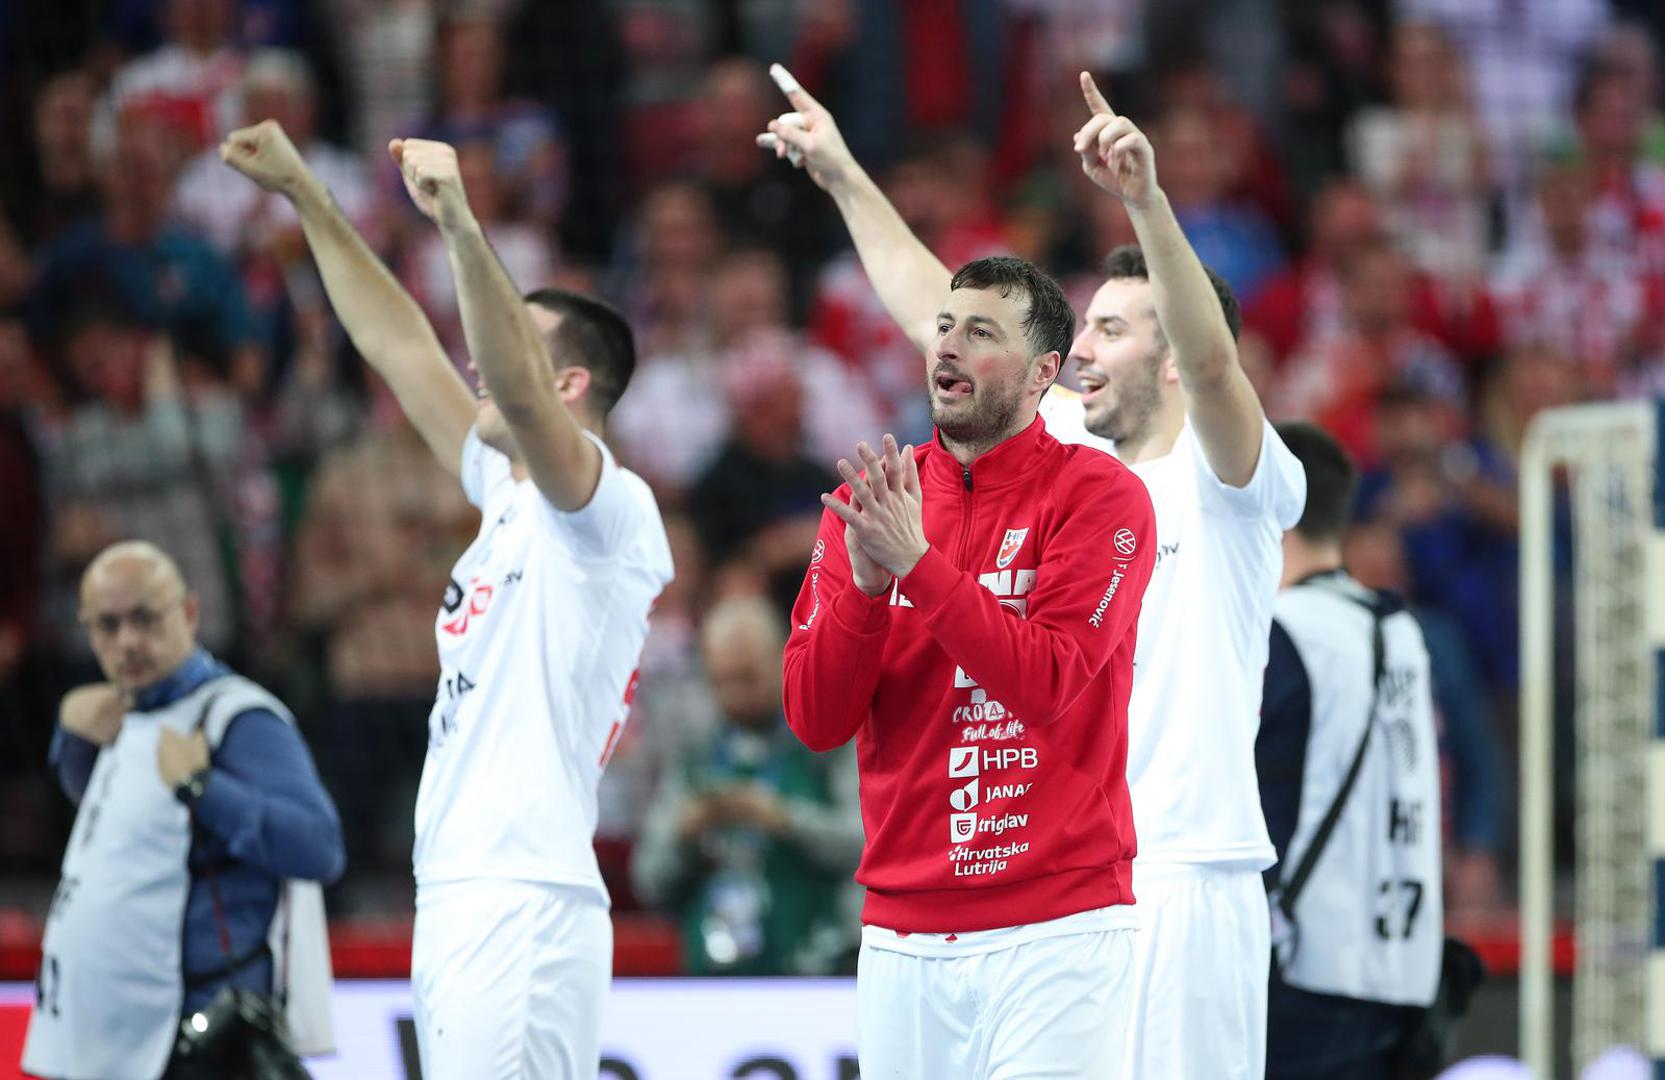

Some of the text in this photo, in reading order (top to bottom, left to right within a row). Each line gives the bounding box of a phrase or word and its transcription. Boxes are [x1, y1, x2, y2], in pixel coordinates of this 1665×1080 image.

[1088, 569, 1125, 629] Jesenović
[983, 747, 1038, 770] HPB
[978, 813, 1028, 836] triglav
[957, 841, 1029, 862] Hrvatska
[955, 860, 1008, 877] Lutrija
